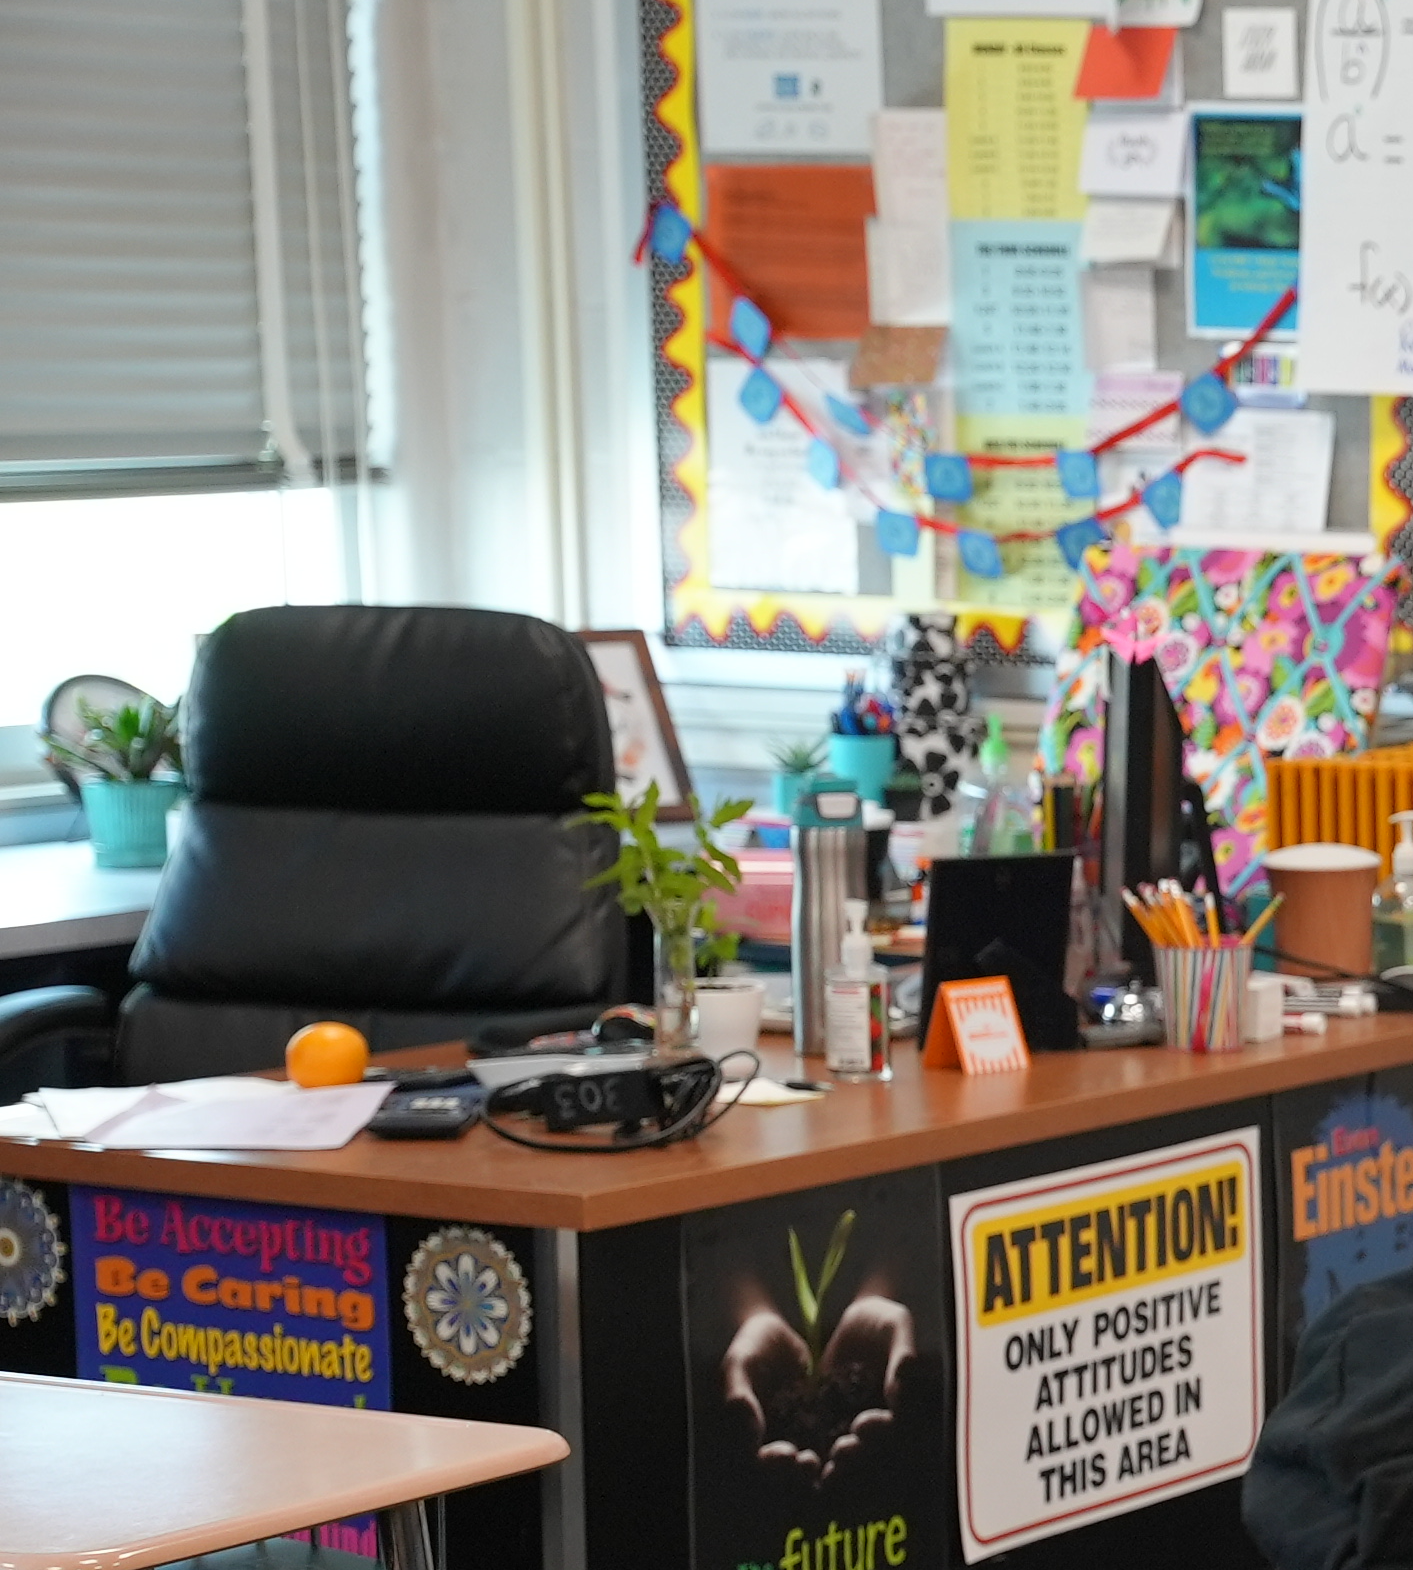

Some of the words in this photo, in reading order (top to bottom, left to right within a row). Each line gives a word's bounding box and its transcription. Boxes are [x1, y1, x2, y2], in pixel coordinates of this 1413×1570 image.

[94, 1195, 150, 1245] Be
[159, 1201, 373, 1286] Accepting
[983, 1176, 1238, 1314] ATTENTION!
[94, 1255, 170, 1300] Be
[181, 1264, 375, 1332] Caring
[1006, 1318, 1080, 1371] ONLY
[1094, 1277, 1221, 1348] POSITIVE
[96, 1302, 138, 1357] Be
[139, 1305, 374, 1383] Compassionate
[1035, 1334, 1194, 1412] ATTITUDES
[1026, 1390, 1164, 1462] ALLOWED
[1174, 1375, 1203, 1417] IN
[1040, 1453, 1106, 1503] THIS
[1119, 1425, 1191, 1480] AREA
[779, 1514, 909, 1570] future
